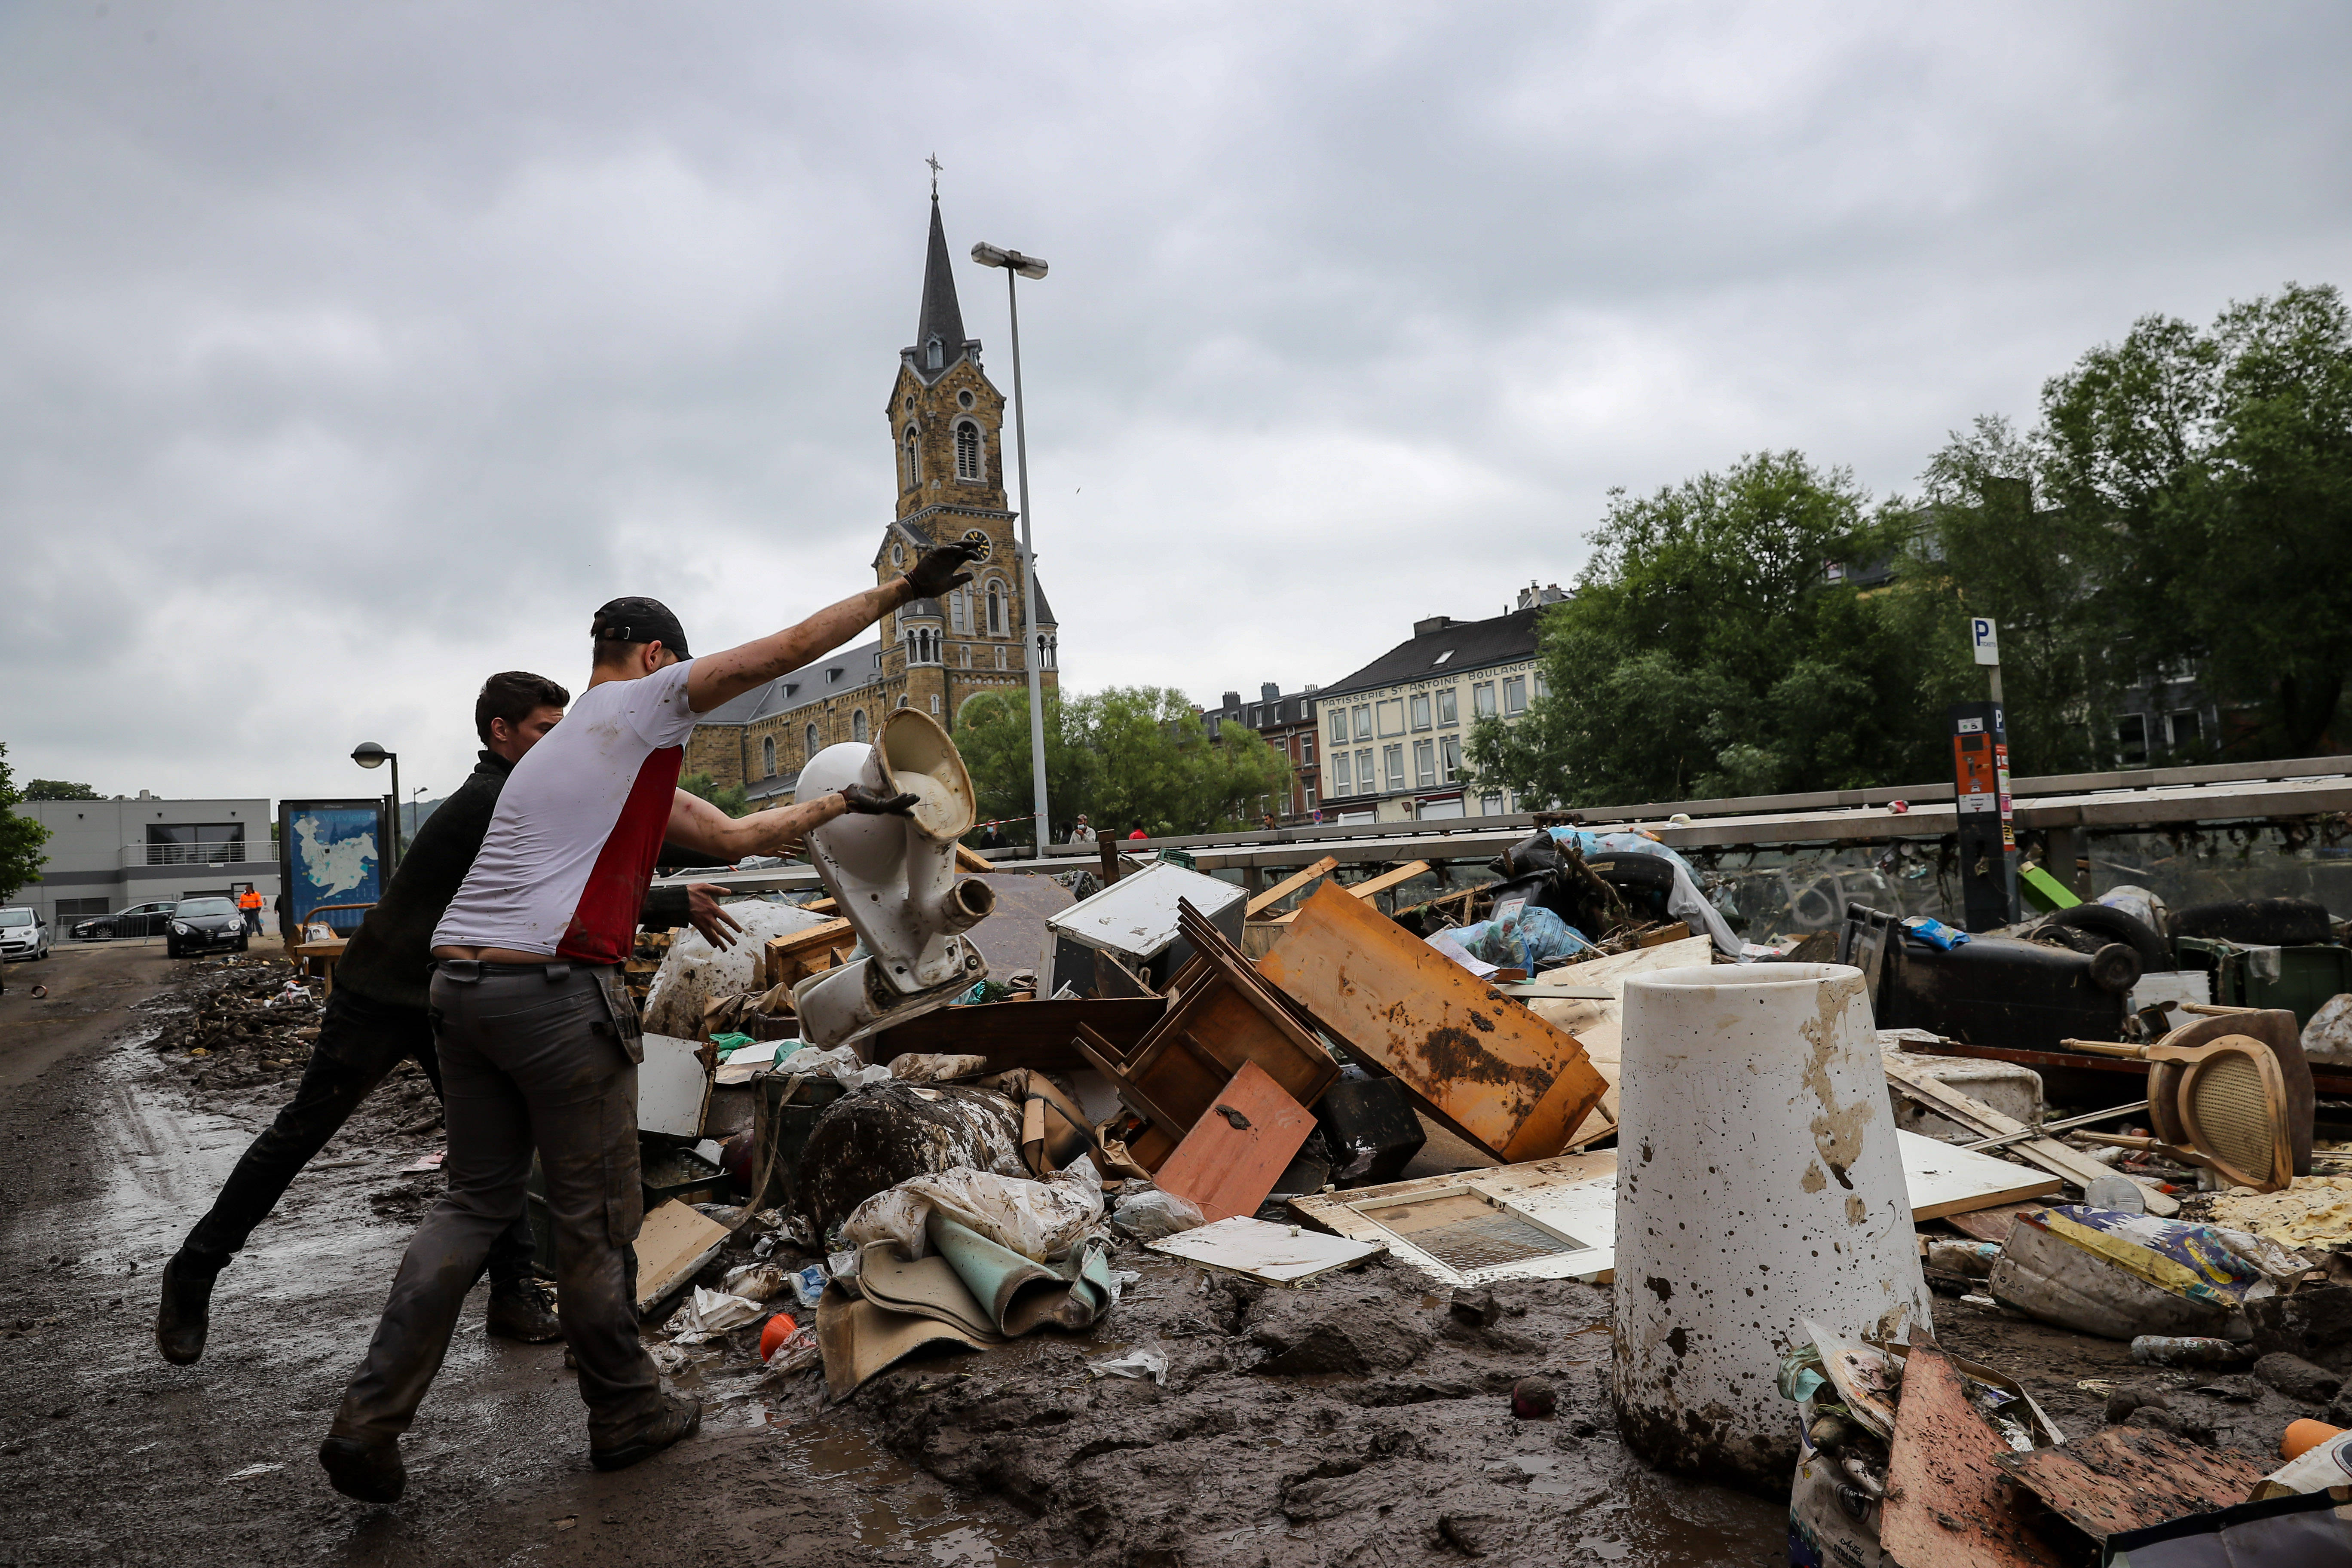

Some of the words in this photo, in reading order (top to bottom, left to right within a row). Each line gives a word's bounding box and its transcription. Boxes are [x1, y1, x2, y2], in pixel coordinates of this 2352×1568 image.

[1975, 620, 1989, 646] P
[1323, 690, 1385, 707] PATISSERIE
[1410, 676, 1460, 691] ANTOINE
[1995, 709, 2003, 728] P
